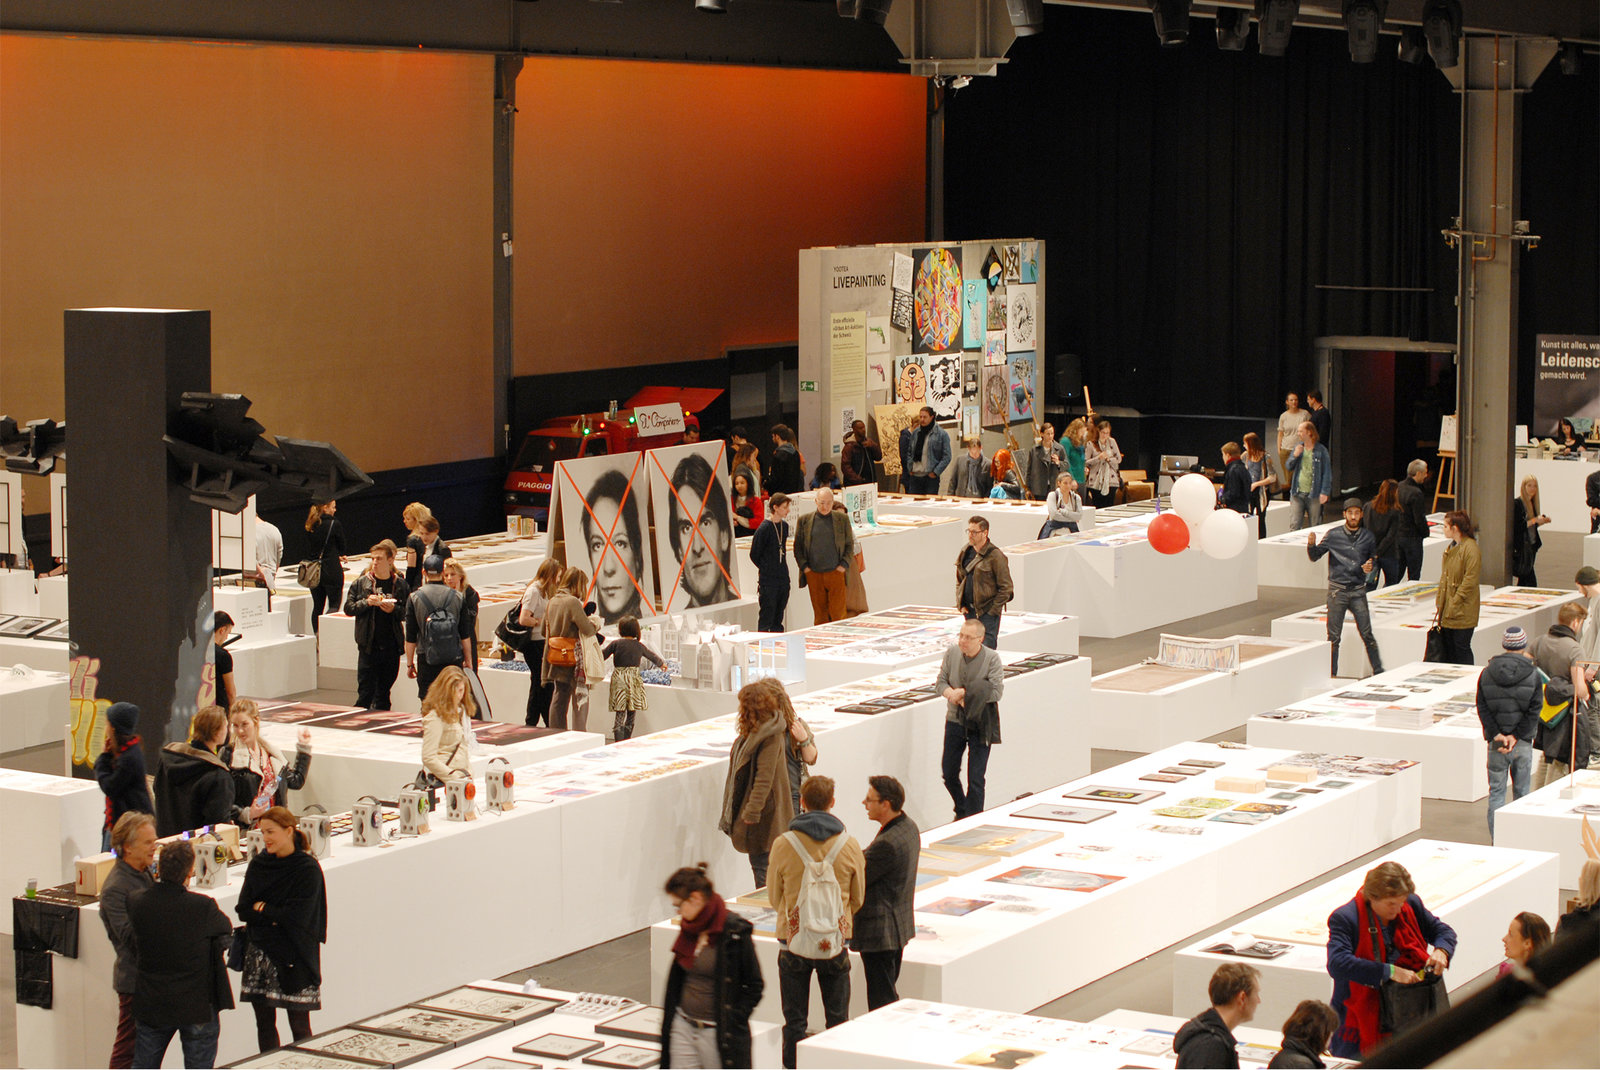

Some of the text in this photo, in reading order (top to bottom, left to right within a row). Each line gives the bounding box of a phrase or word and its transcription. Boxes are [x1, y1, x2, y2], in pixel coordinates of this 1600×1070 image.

[833, 274, 886, 289] LIVEPAINTING
[1541, 340, 1560, 349] Kunst
[1561, 340, 1570, 350] ist
[1570, 341, 1589, 351] alles,
[1539, 371, 1587, 381] gemacht wird.
[517, 481, 552, 490] PIAGGIO
